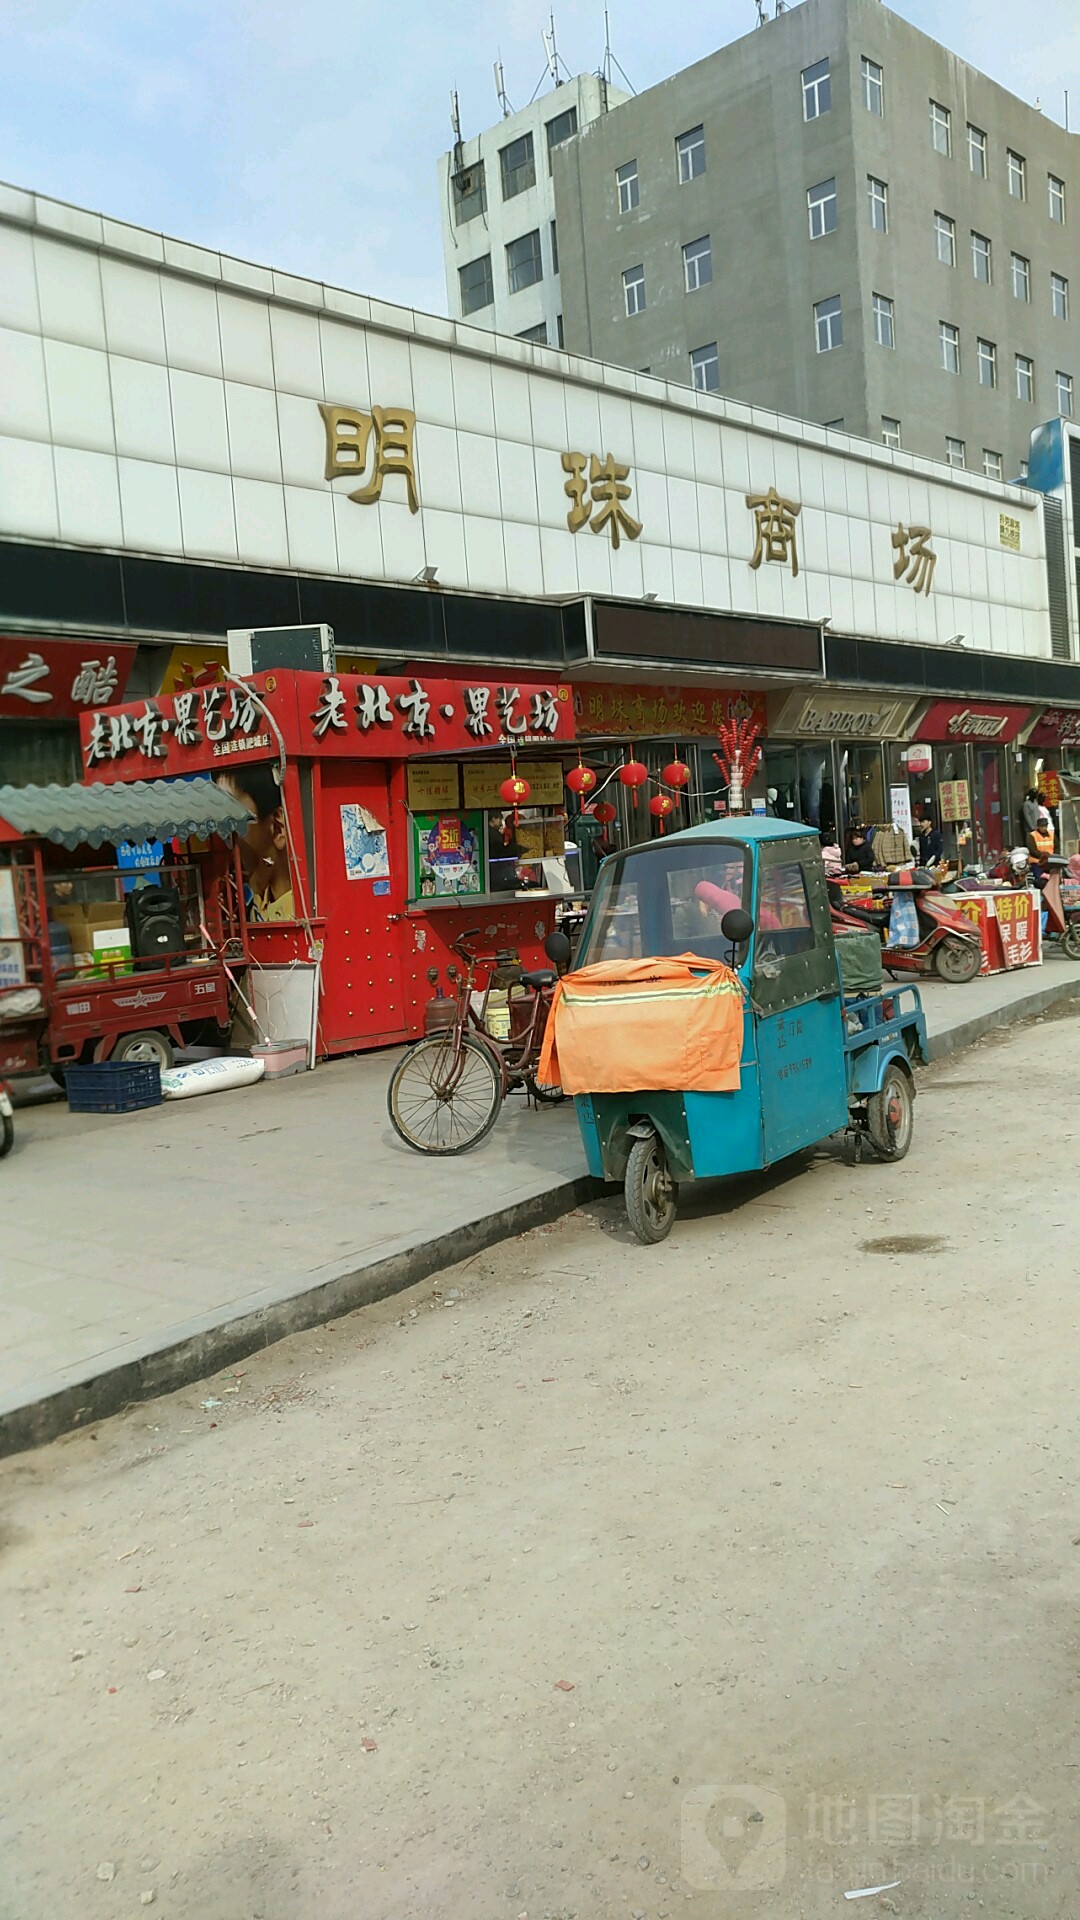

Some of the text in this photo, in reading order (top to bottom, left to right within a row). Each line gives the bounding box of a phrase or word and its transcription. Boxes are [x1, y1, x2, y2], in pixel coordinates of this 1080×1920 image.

[318, 403, 936, 598] 明珠商场
[2, 653, 118, 705] 之酷
[589, 694, 725, 726] 明珠商场欢迎您
[996, 894, 1030, 922] 特价
[1008, 941, 1033, 966] 毛衫
